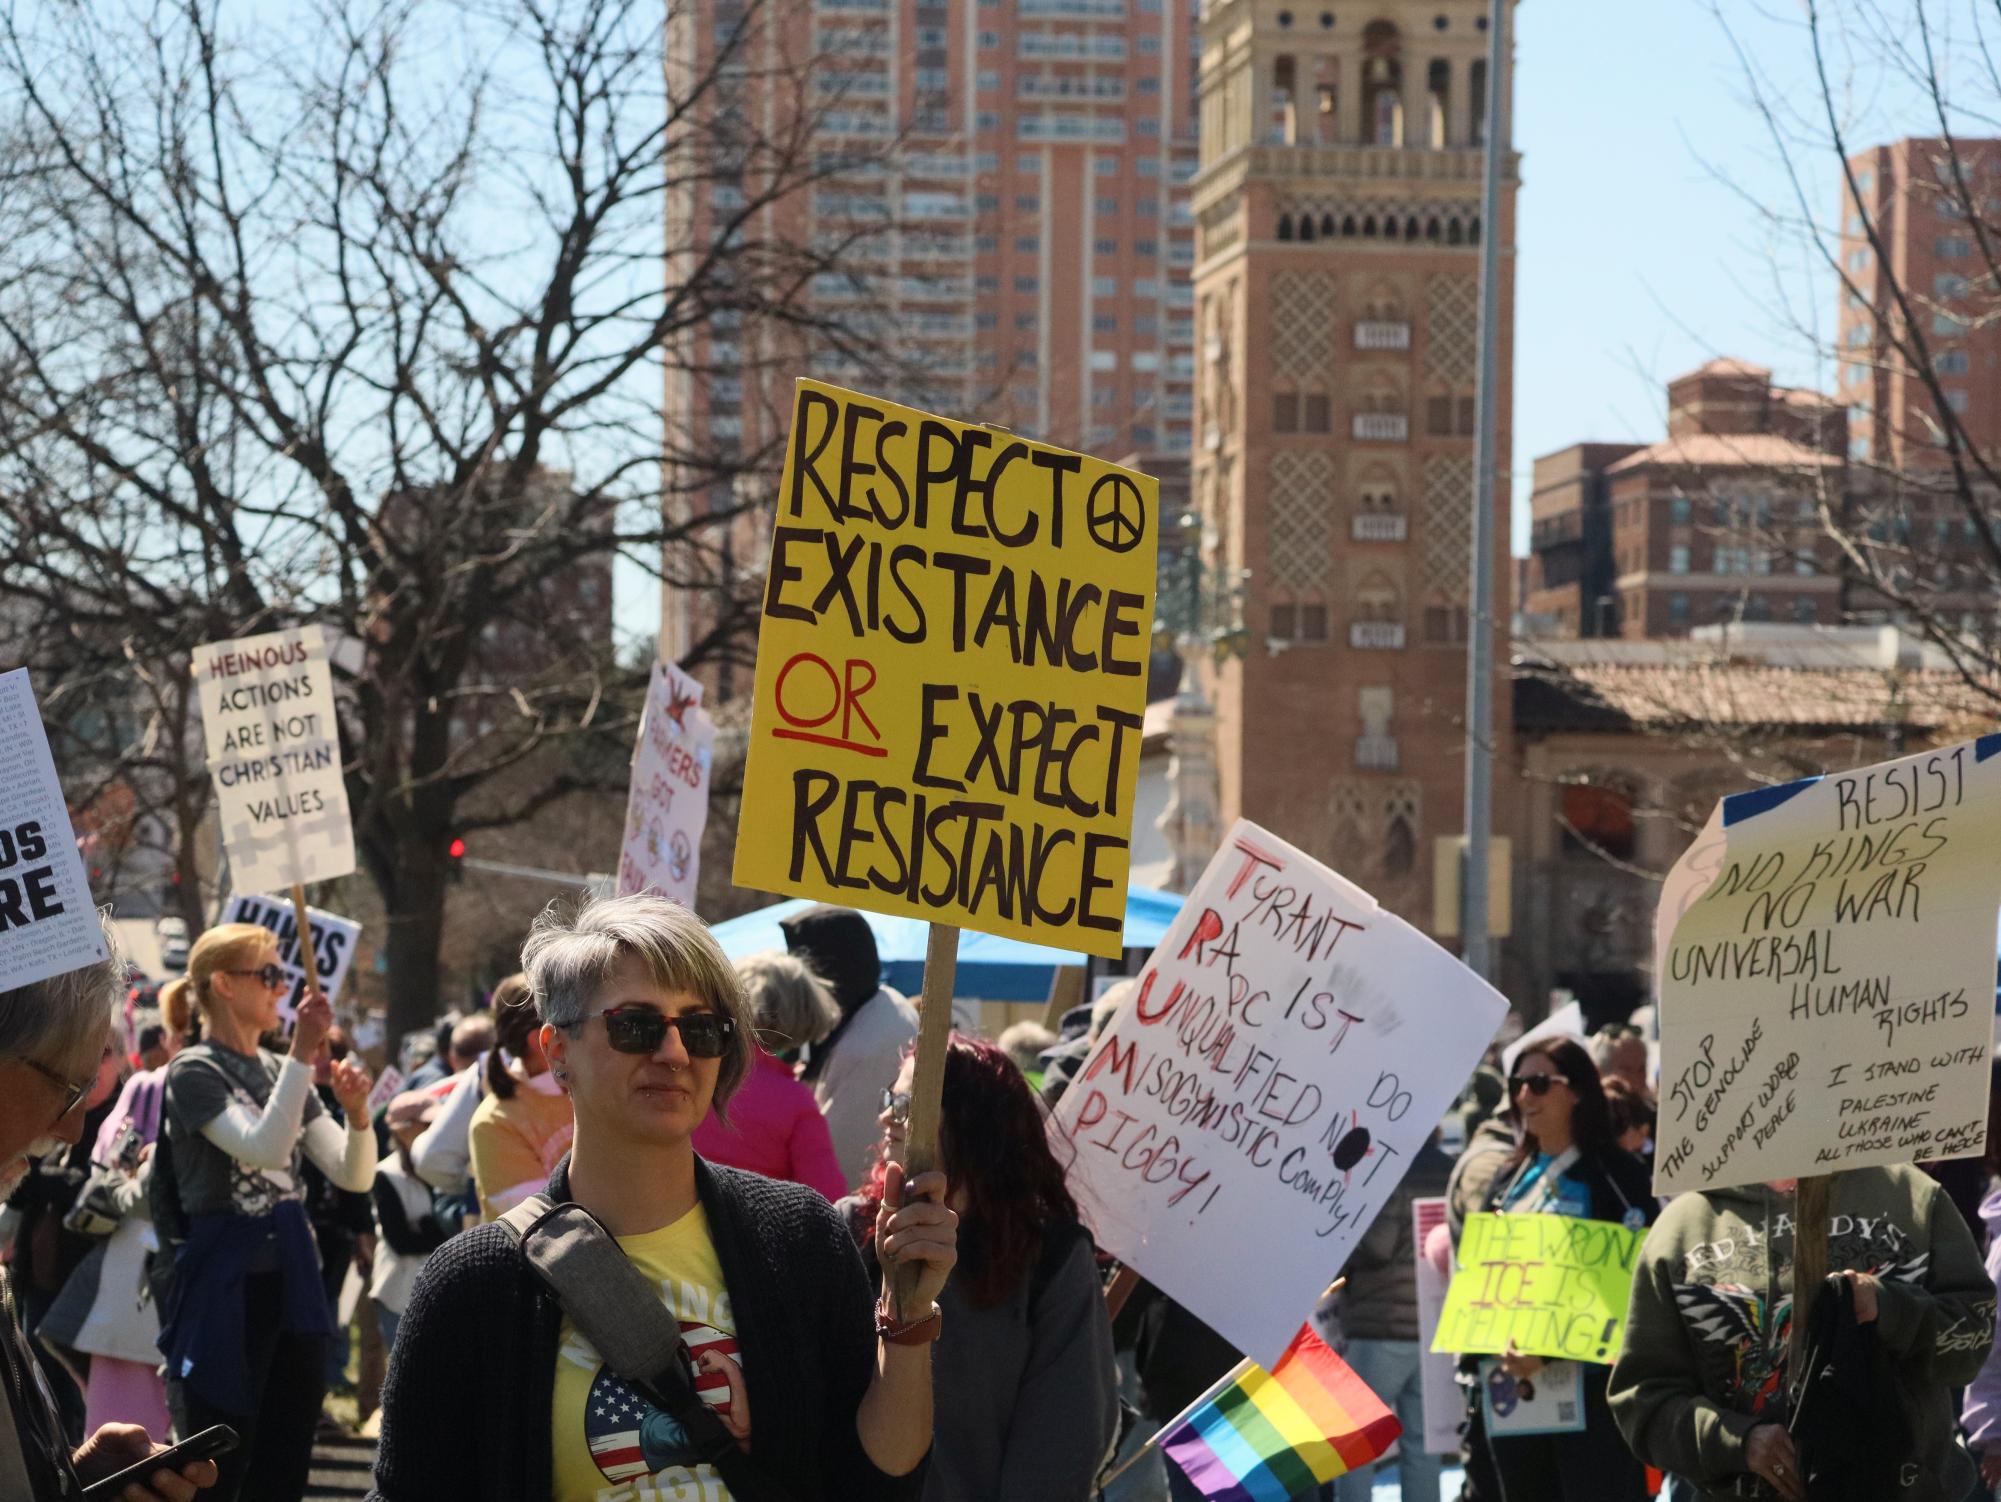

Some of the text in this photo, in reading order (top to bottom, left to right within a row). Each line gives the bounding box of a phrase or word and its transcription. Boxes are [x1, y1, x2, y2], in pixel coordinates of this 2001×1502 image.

[790, 390, 1082, 549] RESPECT
[765, 526, 1145, 676] EXISTANCE
[209, 641, 307, 679] HEINOUS
[219, 675, 313, 714] ACTIONS
[224, 714, 316, 751] ARE NOT
[774, 652, 1143, 818] OR EXPECT
[219, 746, 332, 787] CHRISTIAN
[1835, 747, 1965, 830] RESIST
[247, 790, 324, 824] VALUES
[789, 768, 1128, 931] RESISTANCE
[1707, 817, 1949, 900] NO KINGS
[1225, 838, 1365, 962] TYRANT
[1742, 862, 1927, 933] NO WAR
[1671, 929, 1841, 986] UNIVERSAL
[1789, 976, 1890, 1020] HUMAN
[1873, 988, 1969, 1048] RIGHTS
[1136, 968, 1322, 1126] UNQUALIFIED
[1827, 1044, 1985, 1088] I STAND WITH
[1078, 1034, 1279, 1167] MISOGYNISTIC
[1366, 1070, 1412, 1121] DO
[1670, 1033, 1715, 1122] STOP
[1839, 1083, 1940, 1117] PALESTINE
[1702, 1102, 1755, 1182] SUPPORT
[1752, 1089, 1796, 1150] PEACE
[1815, 1148, 1841, 1164] ALL
[1846, 1135, 1893, 1156] THOSE
[1899, 1130, 1931, 1148] WHO
[1838, 1111, 1930, 1139] UKRAINE
[1071, 1090, 1221, 1226] PIGGY!
[1661, 1136, 1694, 1179] THE
[1913, 1147, 1934, 1163] BE
[1470, 1217, 1531, 1260] THE
[1539, 1214, 1640, 1274] WRON
[1684, 1238, 1735, 1271] ED
[1469, 1260, 1600, 1310] ICE IS
[1449, 1307, 1618, 1358] MELTING!
